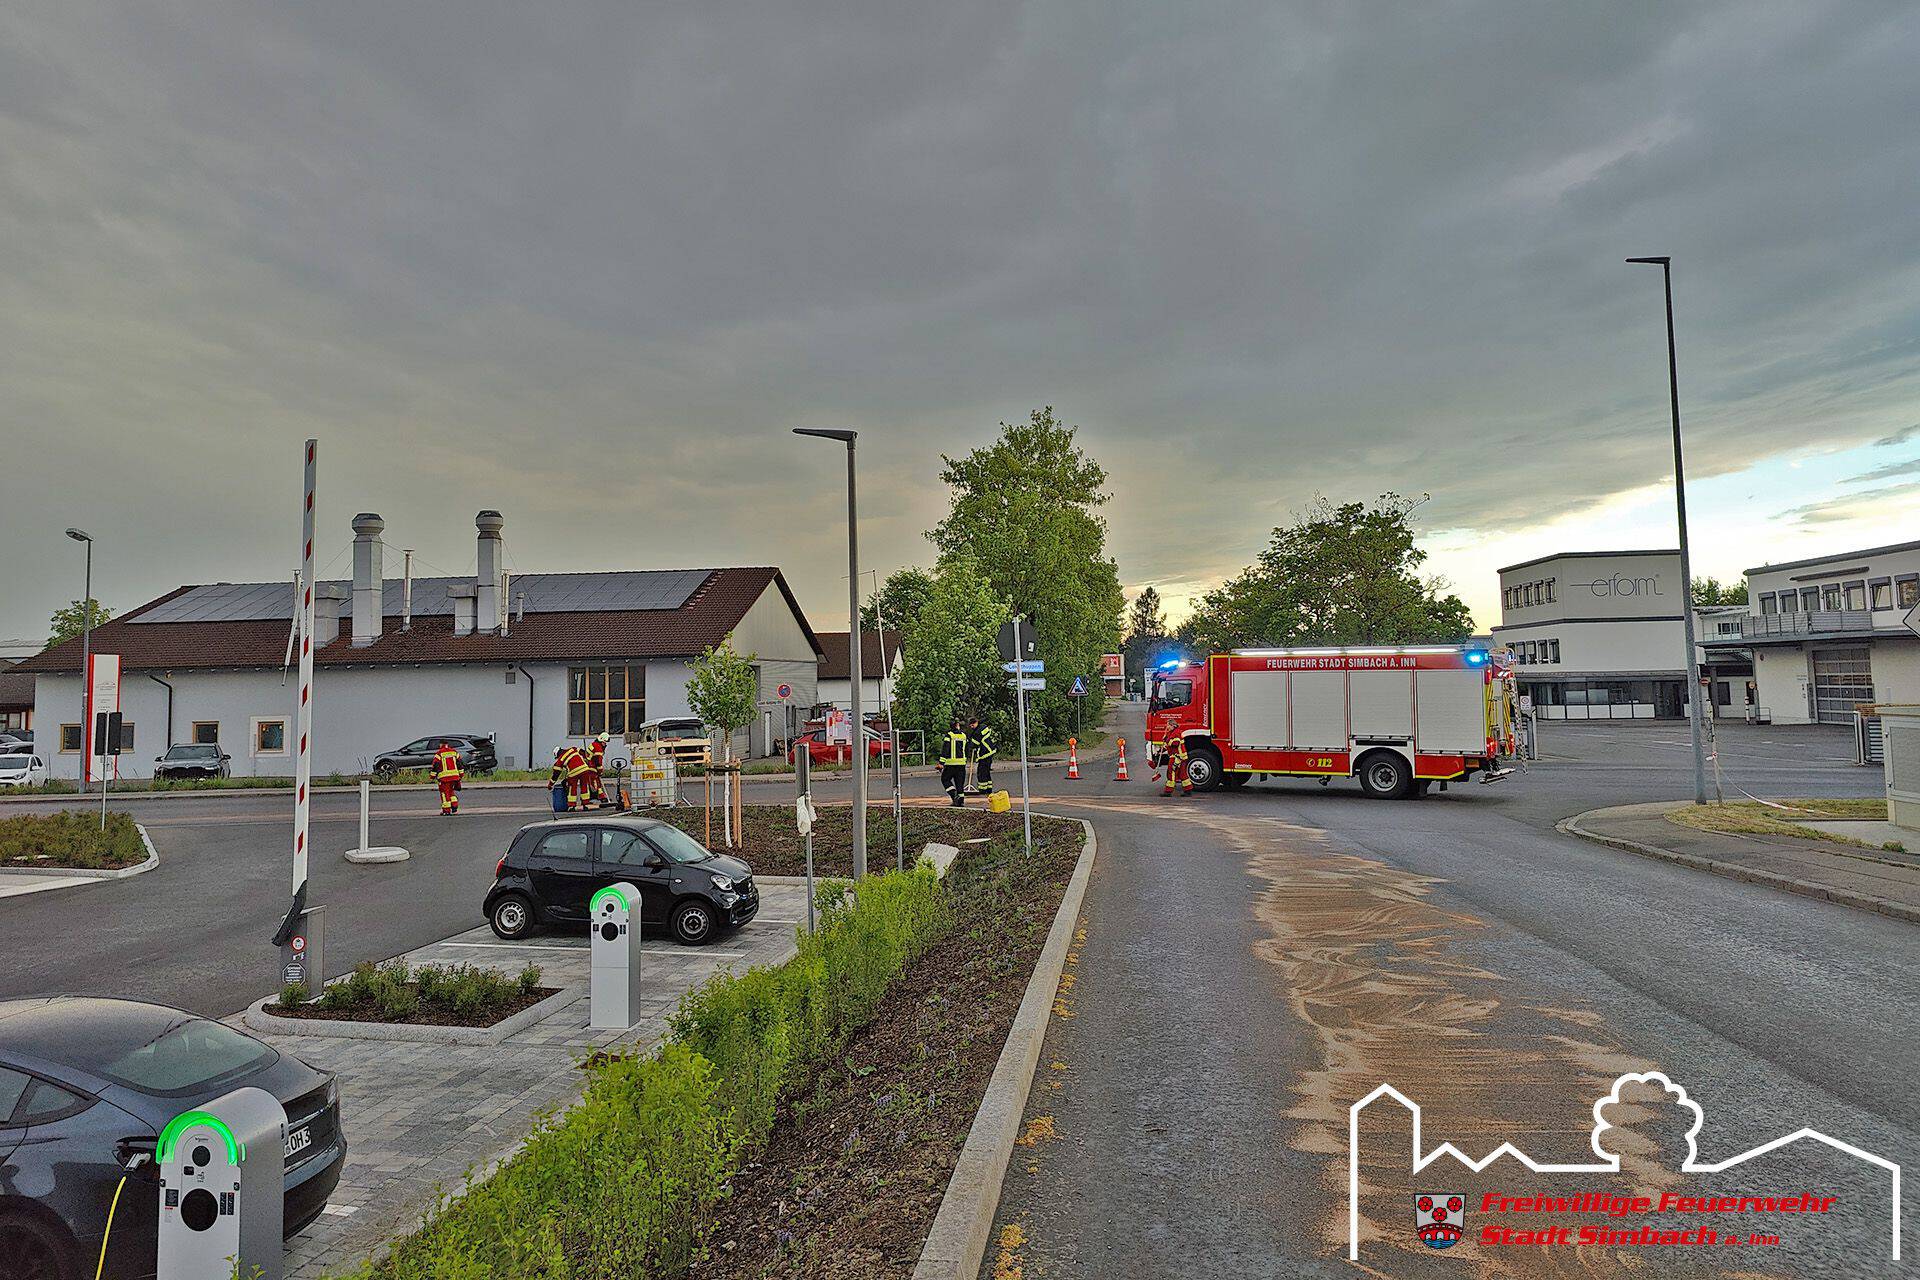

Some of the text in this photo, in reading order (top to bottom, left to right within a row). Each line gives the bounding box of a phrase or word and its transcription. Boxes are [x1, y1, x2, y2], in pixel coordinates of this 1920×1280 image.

[1266, 657, 1416, 668] FEUERWEHR STADT SIMBACH A. INN
[1317, 757, 1333, 768] 112
[290, 1129, 310, 1151] OH 3
